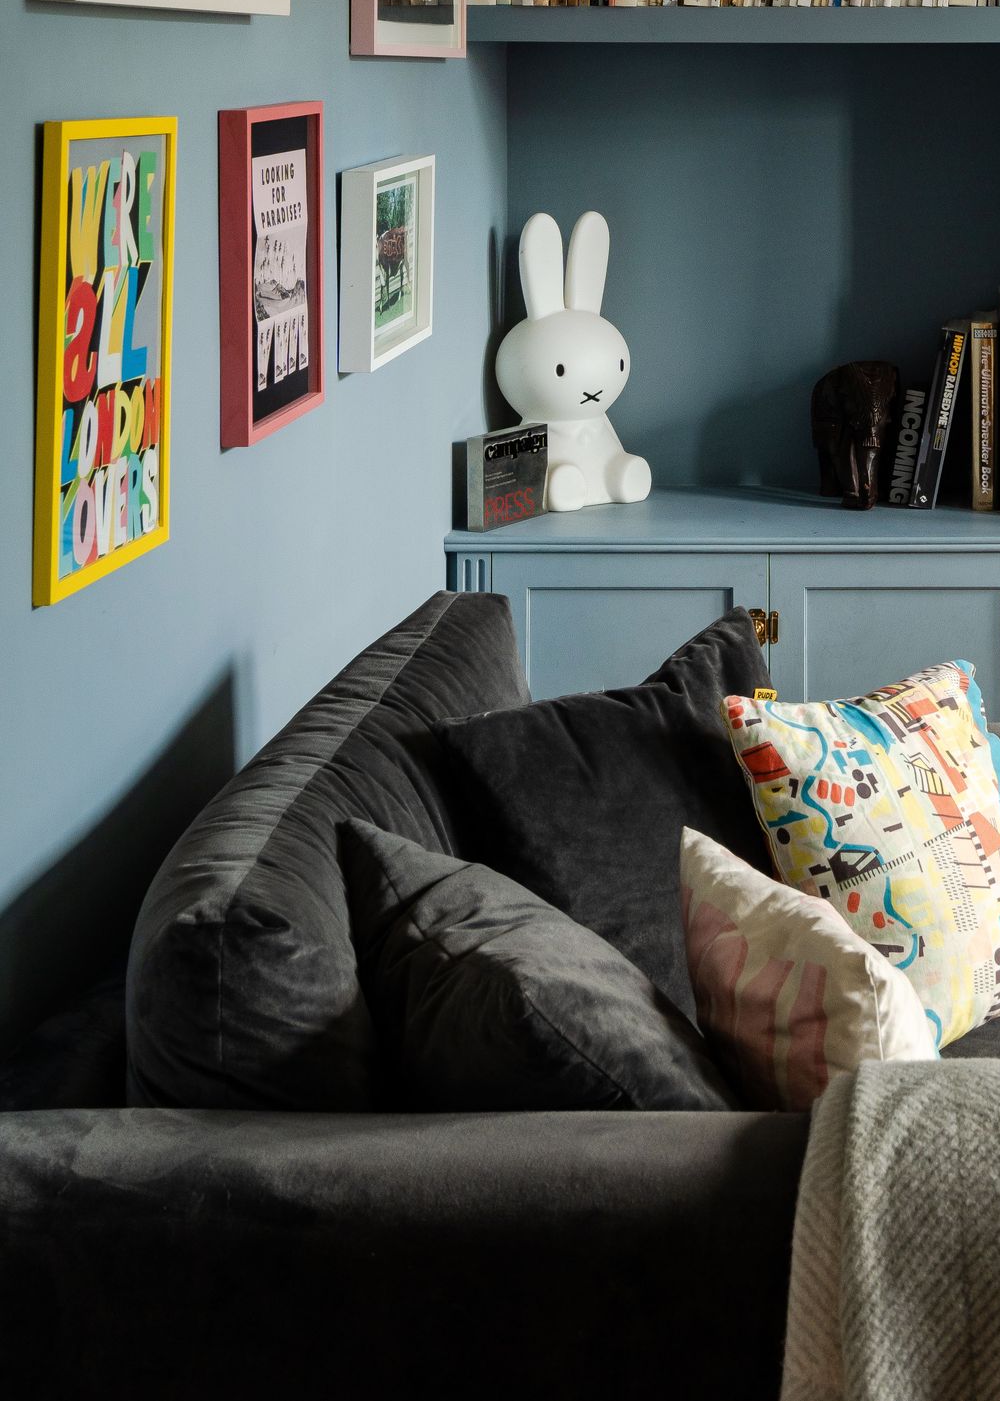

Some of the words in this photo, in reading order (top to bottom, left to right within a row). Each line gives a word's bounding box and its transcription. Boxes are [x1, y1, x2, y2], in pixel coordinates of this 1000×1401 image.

[260, 162, 295, 187] LOOKING
[271, 186, 287, 204] FOR
[260, 202, 303, 230] PARADISE?
[951, 334, 964, 354] HIP
[980, 344, 991, 365] The
[947, 353, 961, 375] HOP
[942, 375, 956, 412] RAISED
[980, 368, 991, 416] Ultimate
[61, 378, 161, 485] LONDON
[980, 418, 991, 464] Sneaker
[889, 389, 925, 504] INCOMING
[980, 467, 991, 495] Book
[59, 449, 159, 580] LOVERS
[757, 691, 774, 700] RUDE
